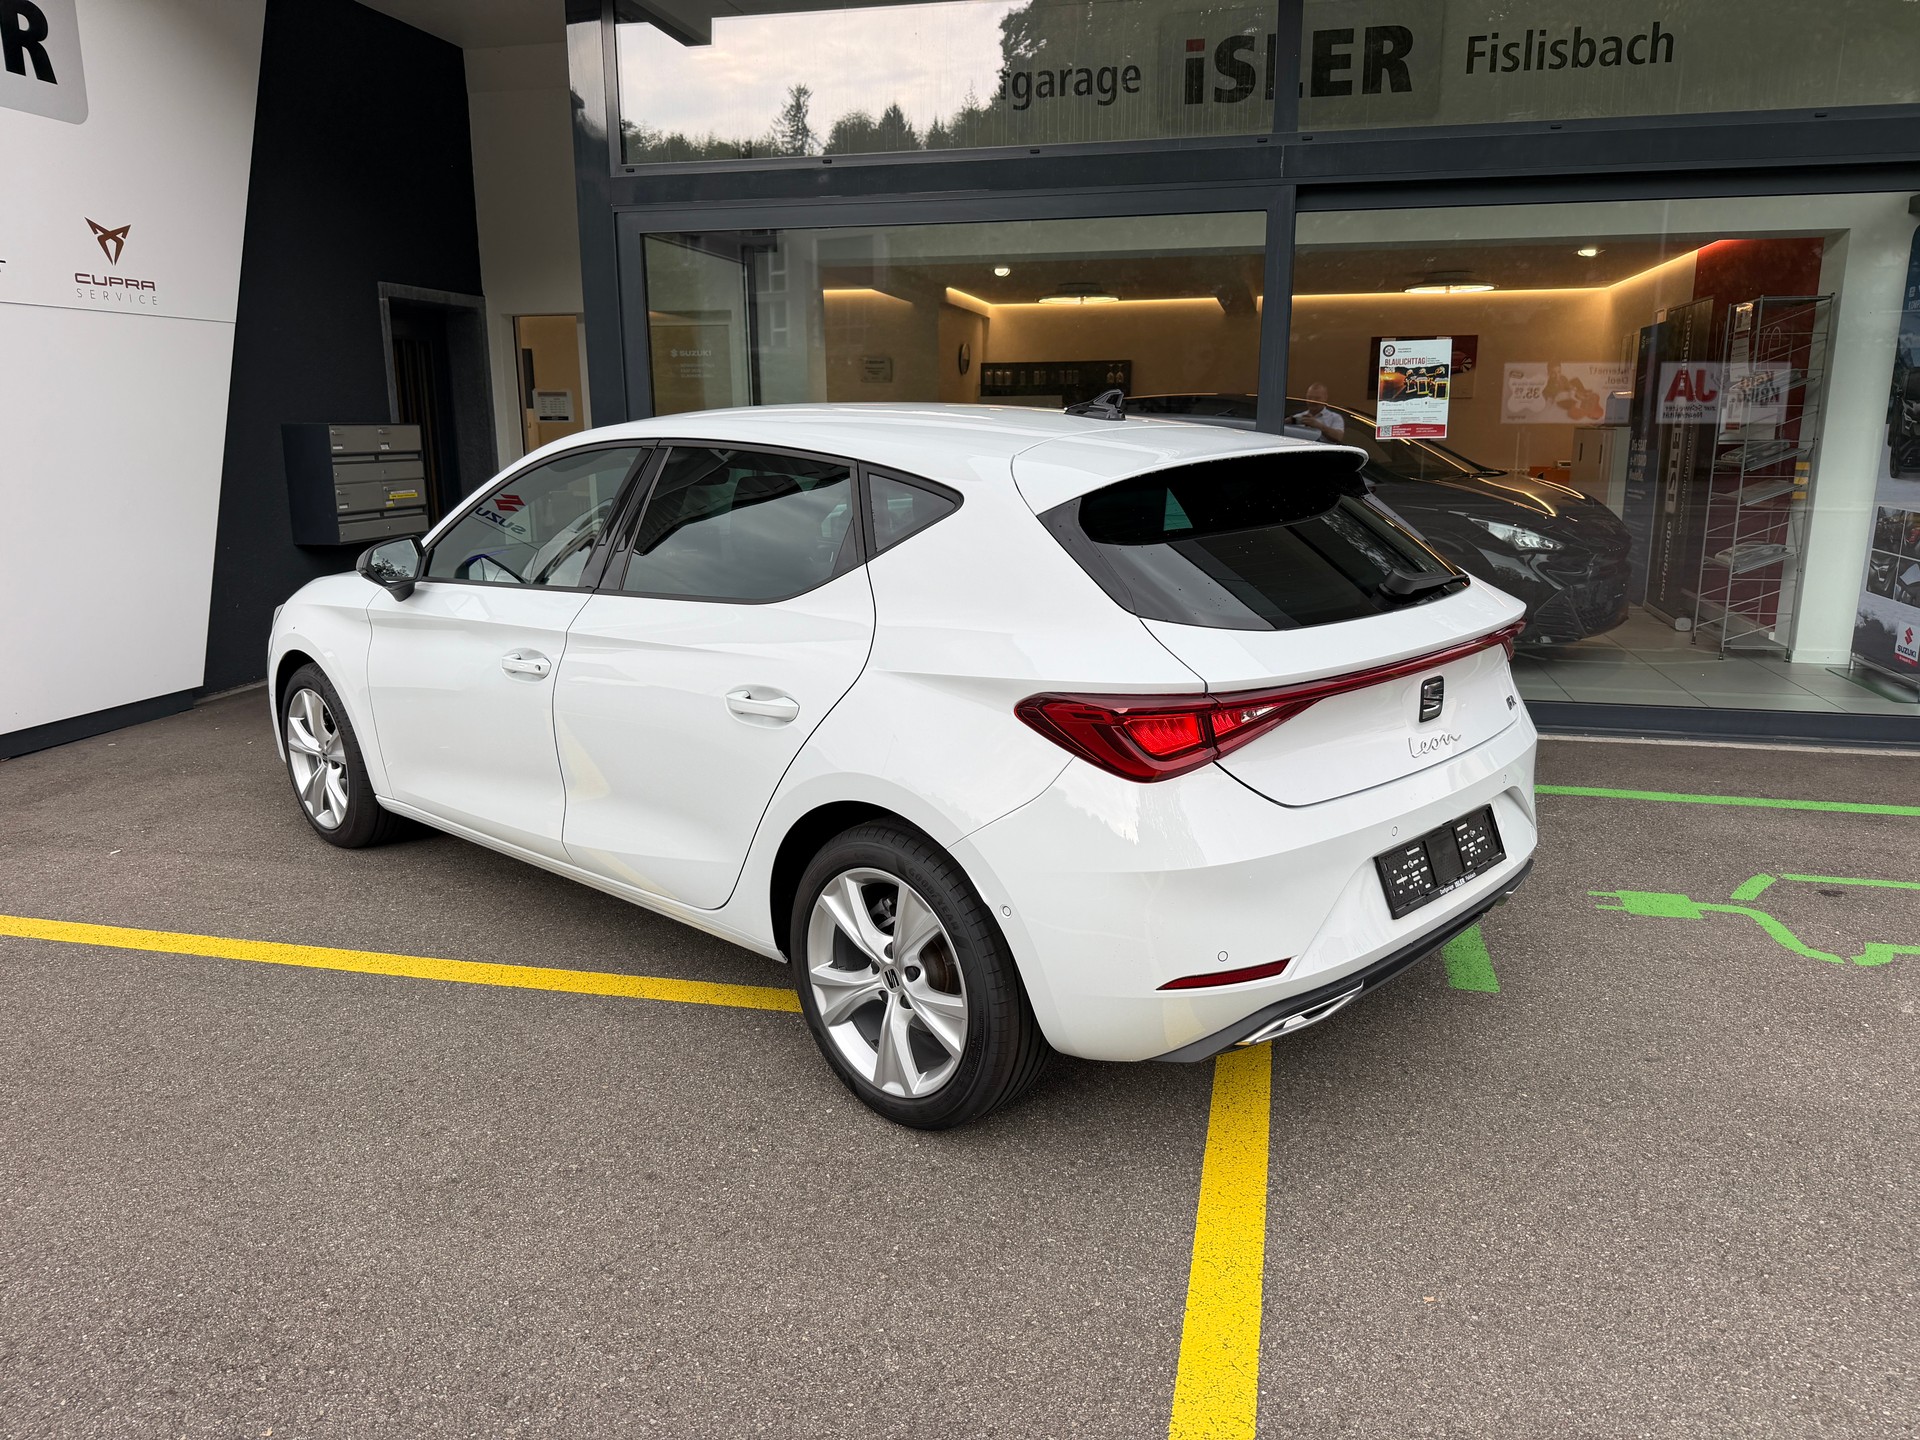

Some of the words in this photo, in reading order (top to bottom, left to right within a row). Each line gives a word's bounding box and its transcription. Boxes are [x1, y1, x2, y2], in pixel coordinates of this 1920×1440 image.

[1465, 21, 1674, 75] Fislisbach
[74, 272, 157, 292] CUPRA
[76, 288, 158, 306] SERVICE
[679, 349, 712, 357] SUZUKI
[1384, 356, 1426, 367] BLAULICHTTAG
[1660, 521, 1672, 601] Dorfgarage
[1896, 644, 1917, 658] SUZUKI
[1407, 732, 1462, 759] Leon
